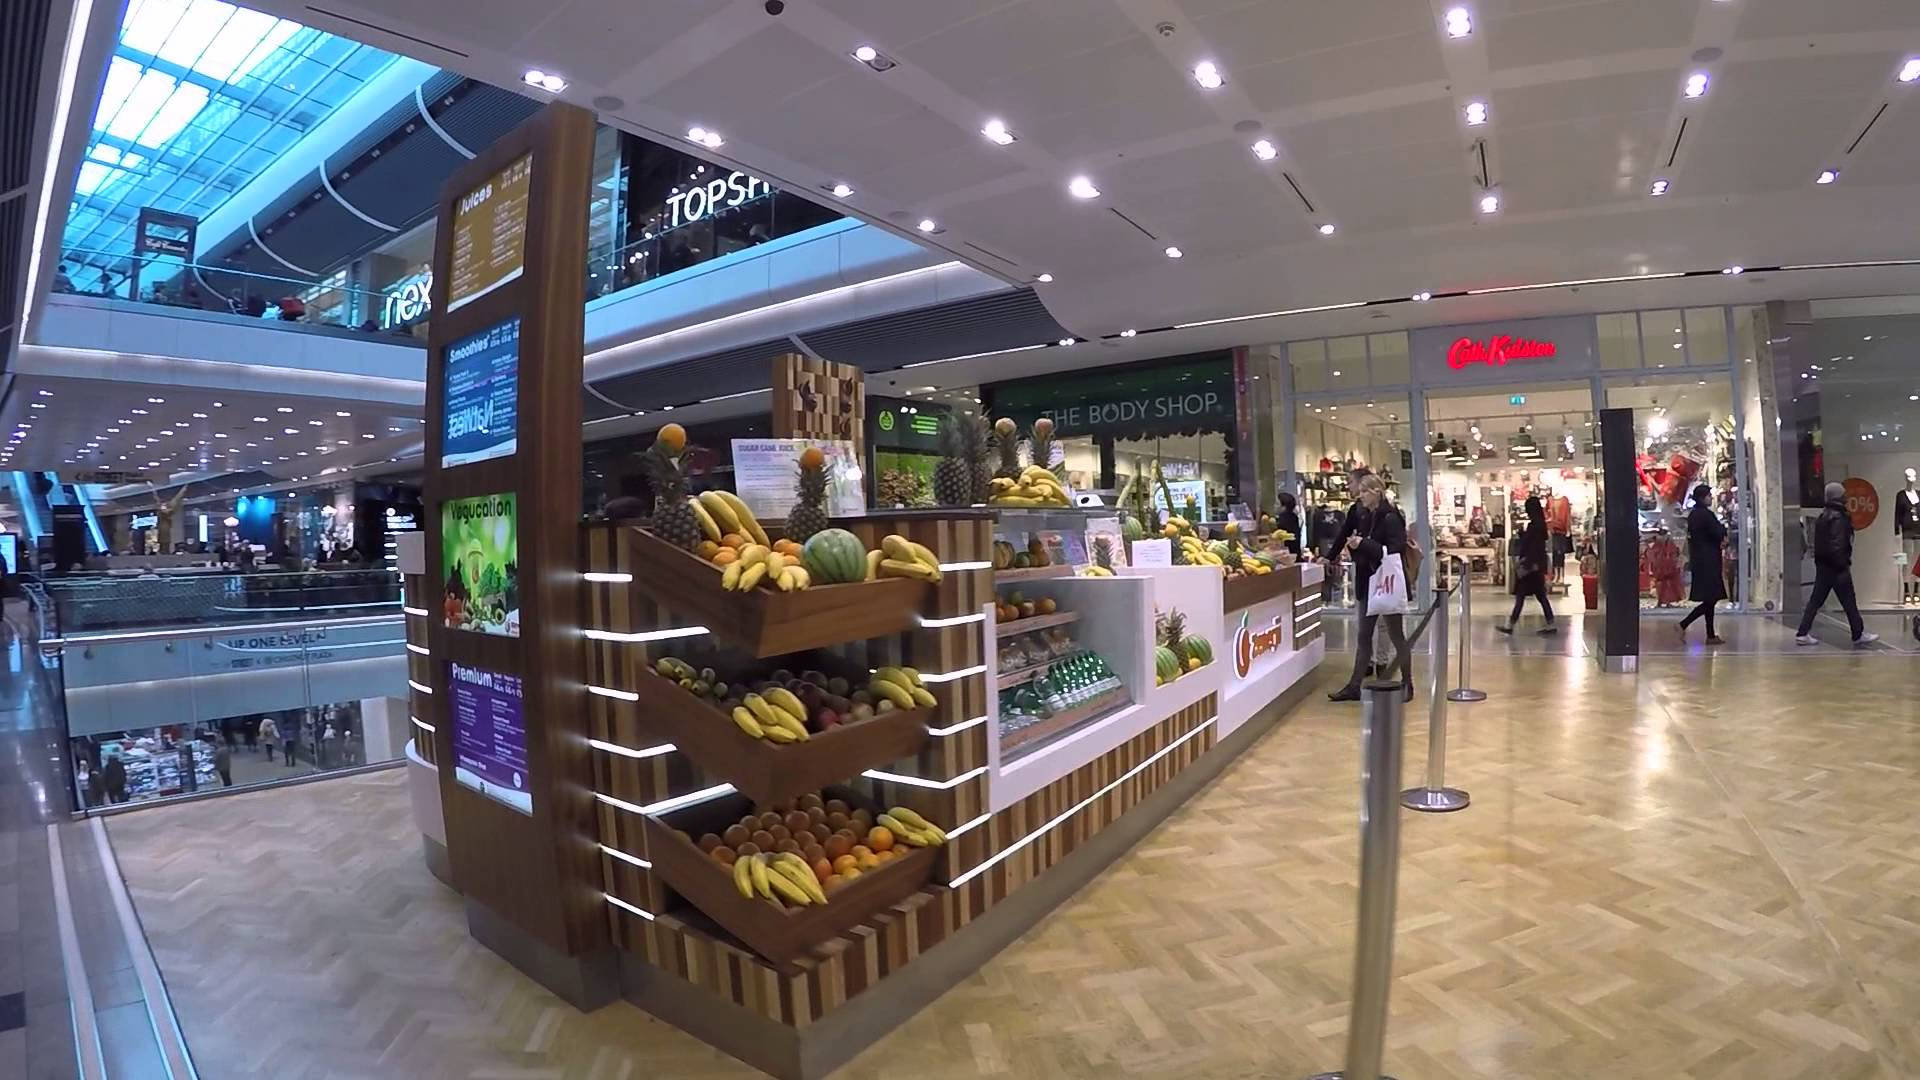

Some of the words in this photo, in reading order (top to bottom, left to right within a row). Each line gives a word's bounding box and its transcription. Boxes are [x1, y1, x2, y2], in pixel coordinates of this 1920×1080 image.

[460, 184, 493, 216] Juices
[1089, 400, 1149, 424] BODY
[1155, 393, 1218, 418] SHOP
[1844, 496, 1874, 513] 0%
[249, 636, 277, 648] ONE
[452, 662, 493, 688] Premium
